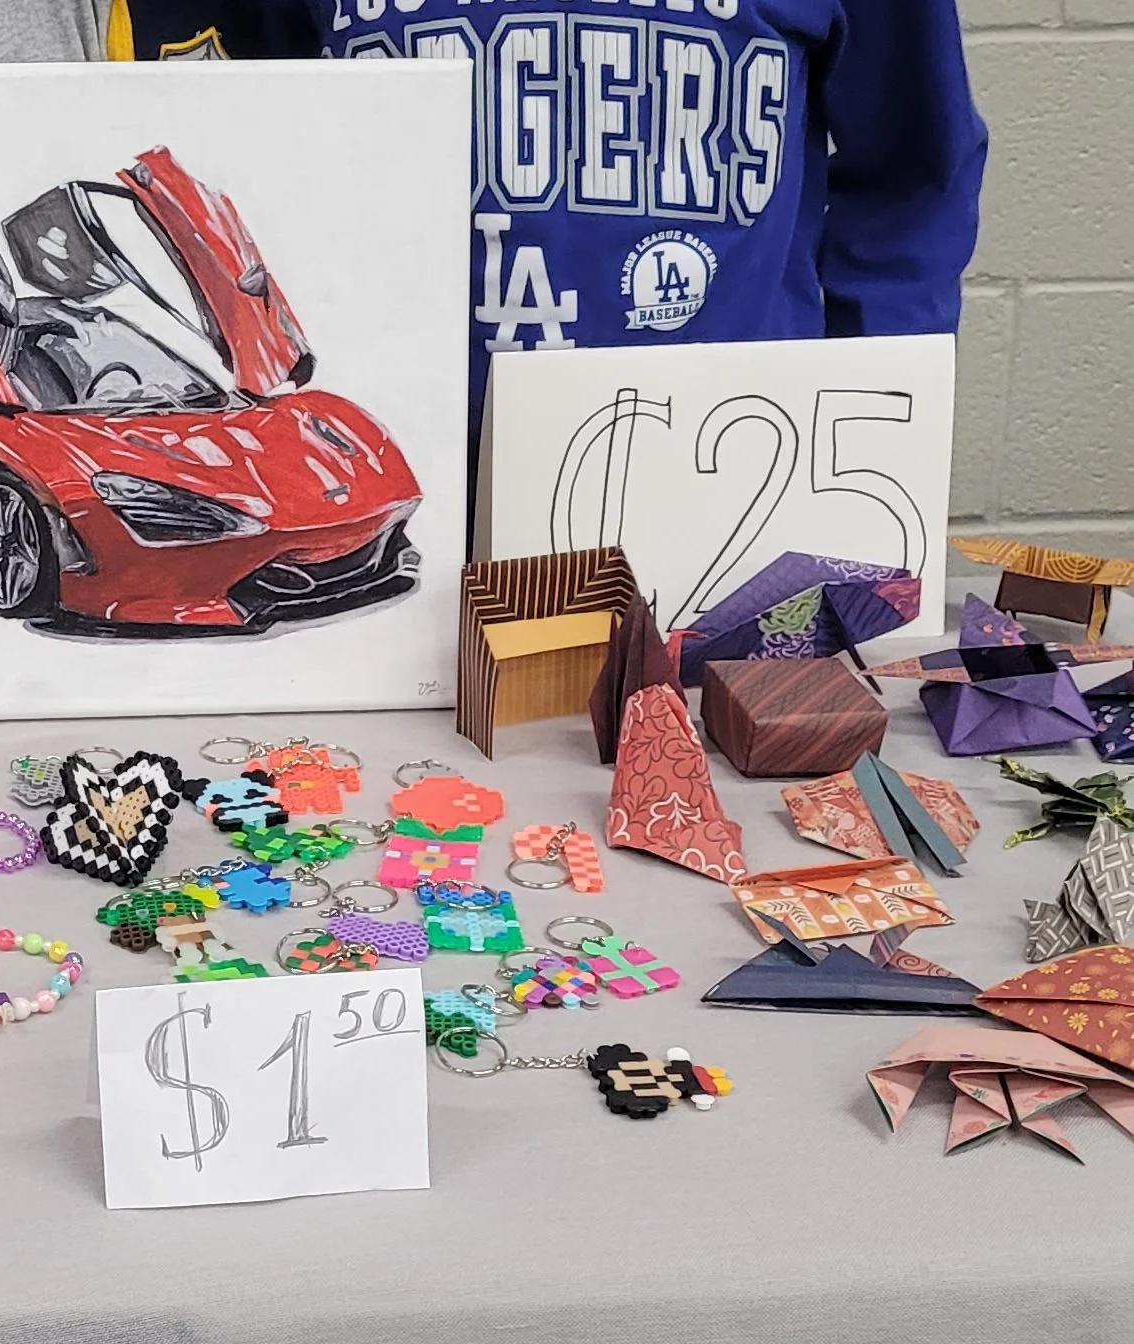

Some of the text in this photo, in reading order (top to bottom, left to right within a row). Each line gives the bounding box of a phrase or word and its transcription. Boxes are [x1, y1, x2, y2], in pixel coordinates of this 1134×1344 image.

[319, 12, 789, 227] GERS
[474, 213, 579, 352] LA
[621, 251, 638, 296] MAJOR
[635, 230, 682, 253] LEAGUE
[652, 251, 690, 303] LA
